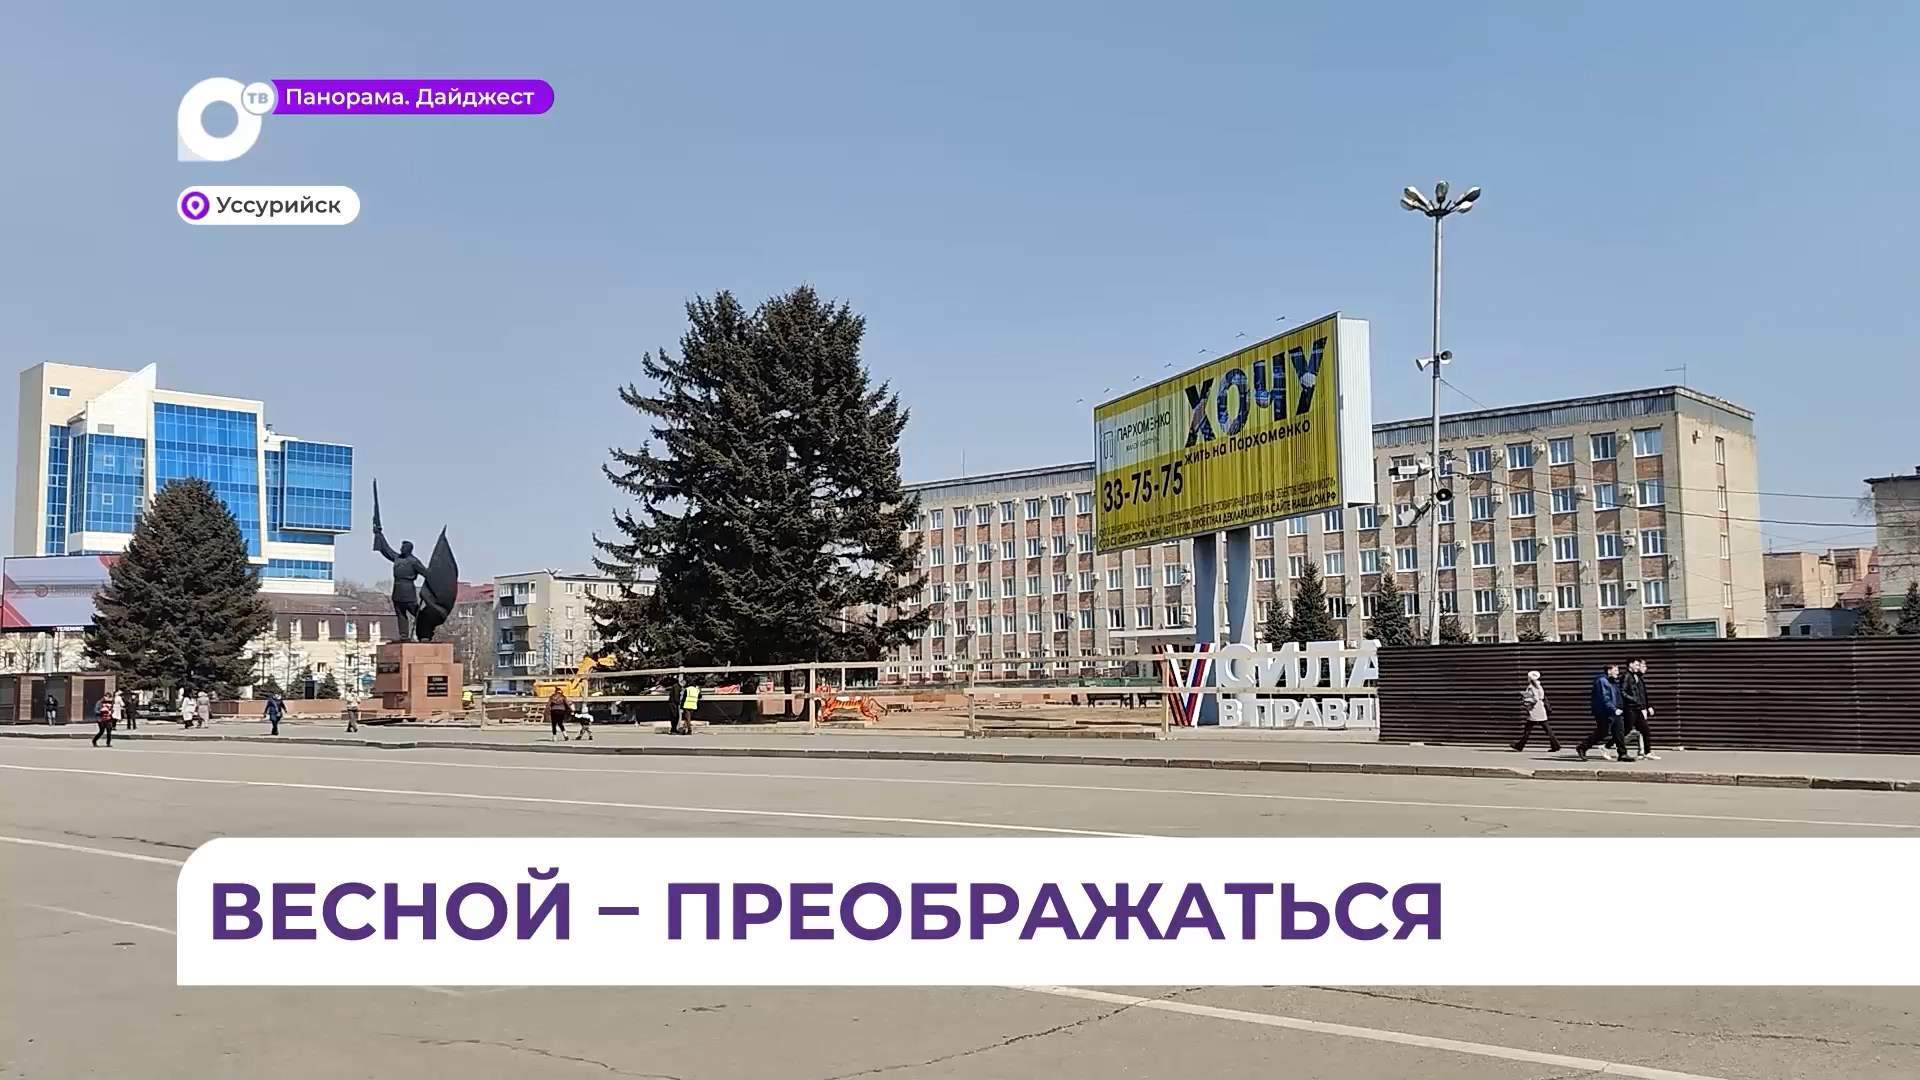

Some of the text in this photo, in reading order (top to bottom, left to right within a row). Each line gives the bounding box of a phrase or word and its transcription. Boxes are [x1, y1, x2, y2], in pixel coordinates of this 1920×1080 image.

[1184, 336, 1328, 449] ХОЧУ
[1117, 411, 1171, 442] ПАРХОМЕНКО
[1184, 419, 1311, 467] жить на Пархоменко
[1103, 461, 1184, 512] 33-75-75
[1218, 697, 1375, 728] В ПРАВД
